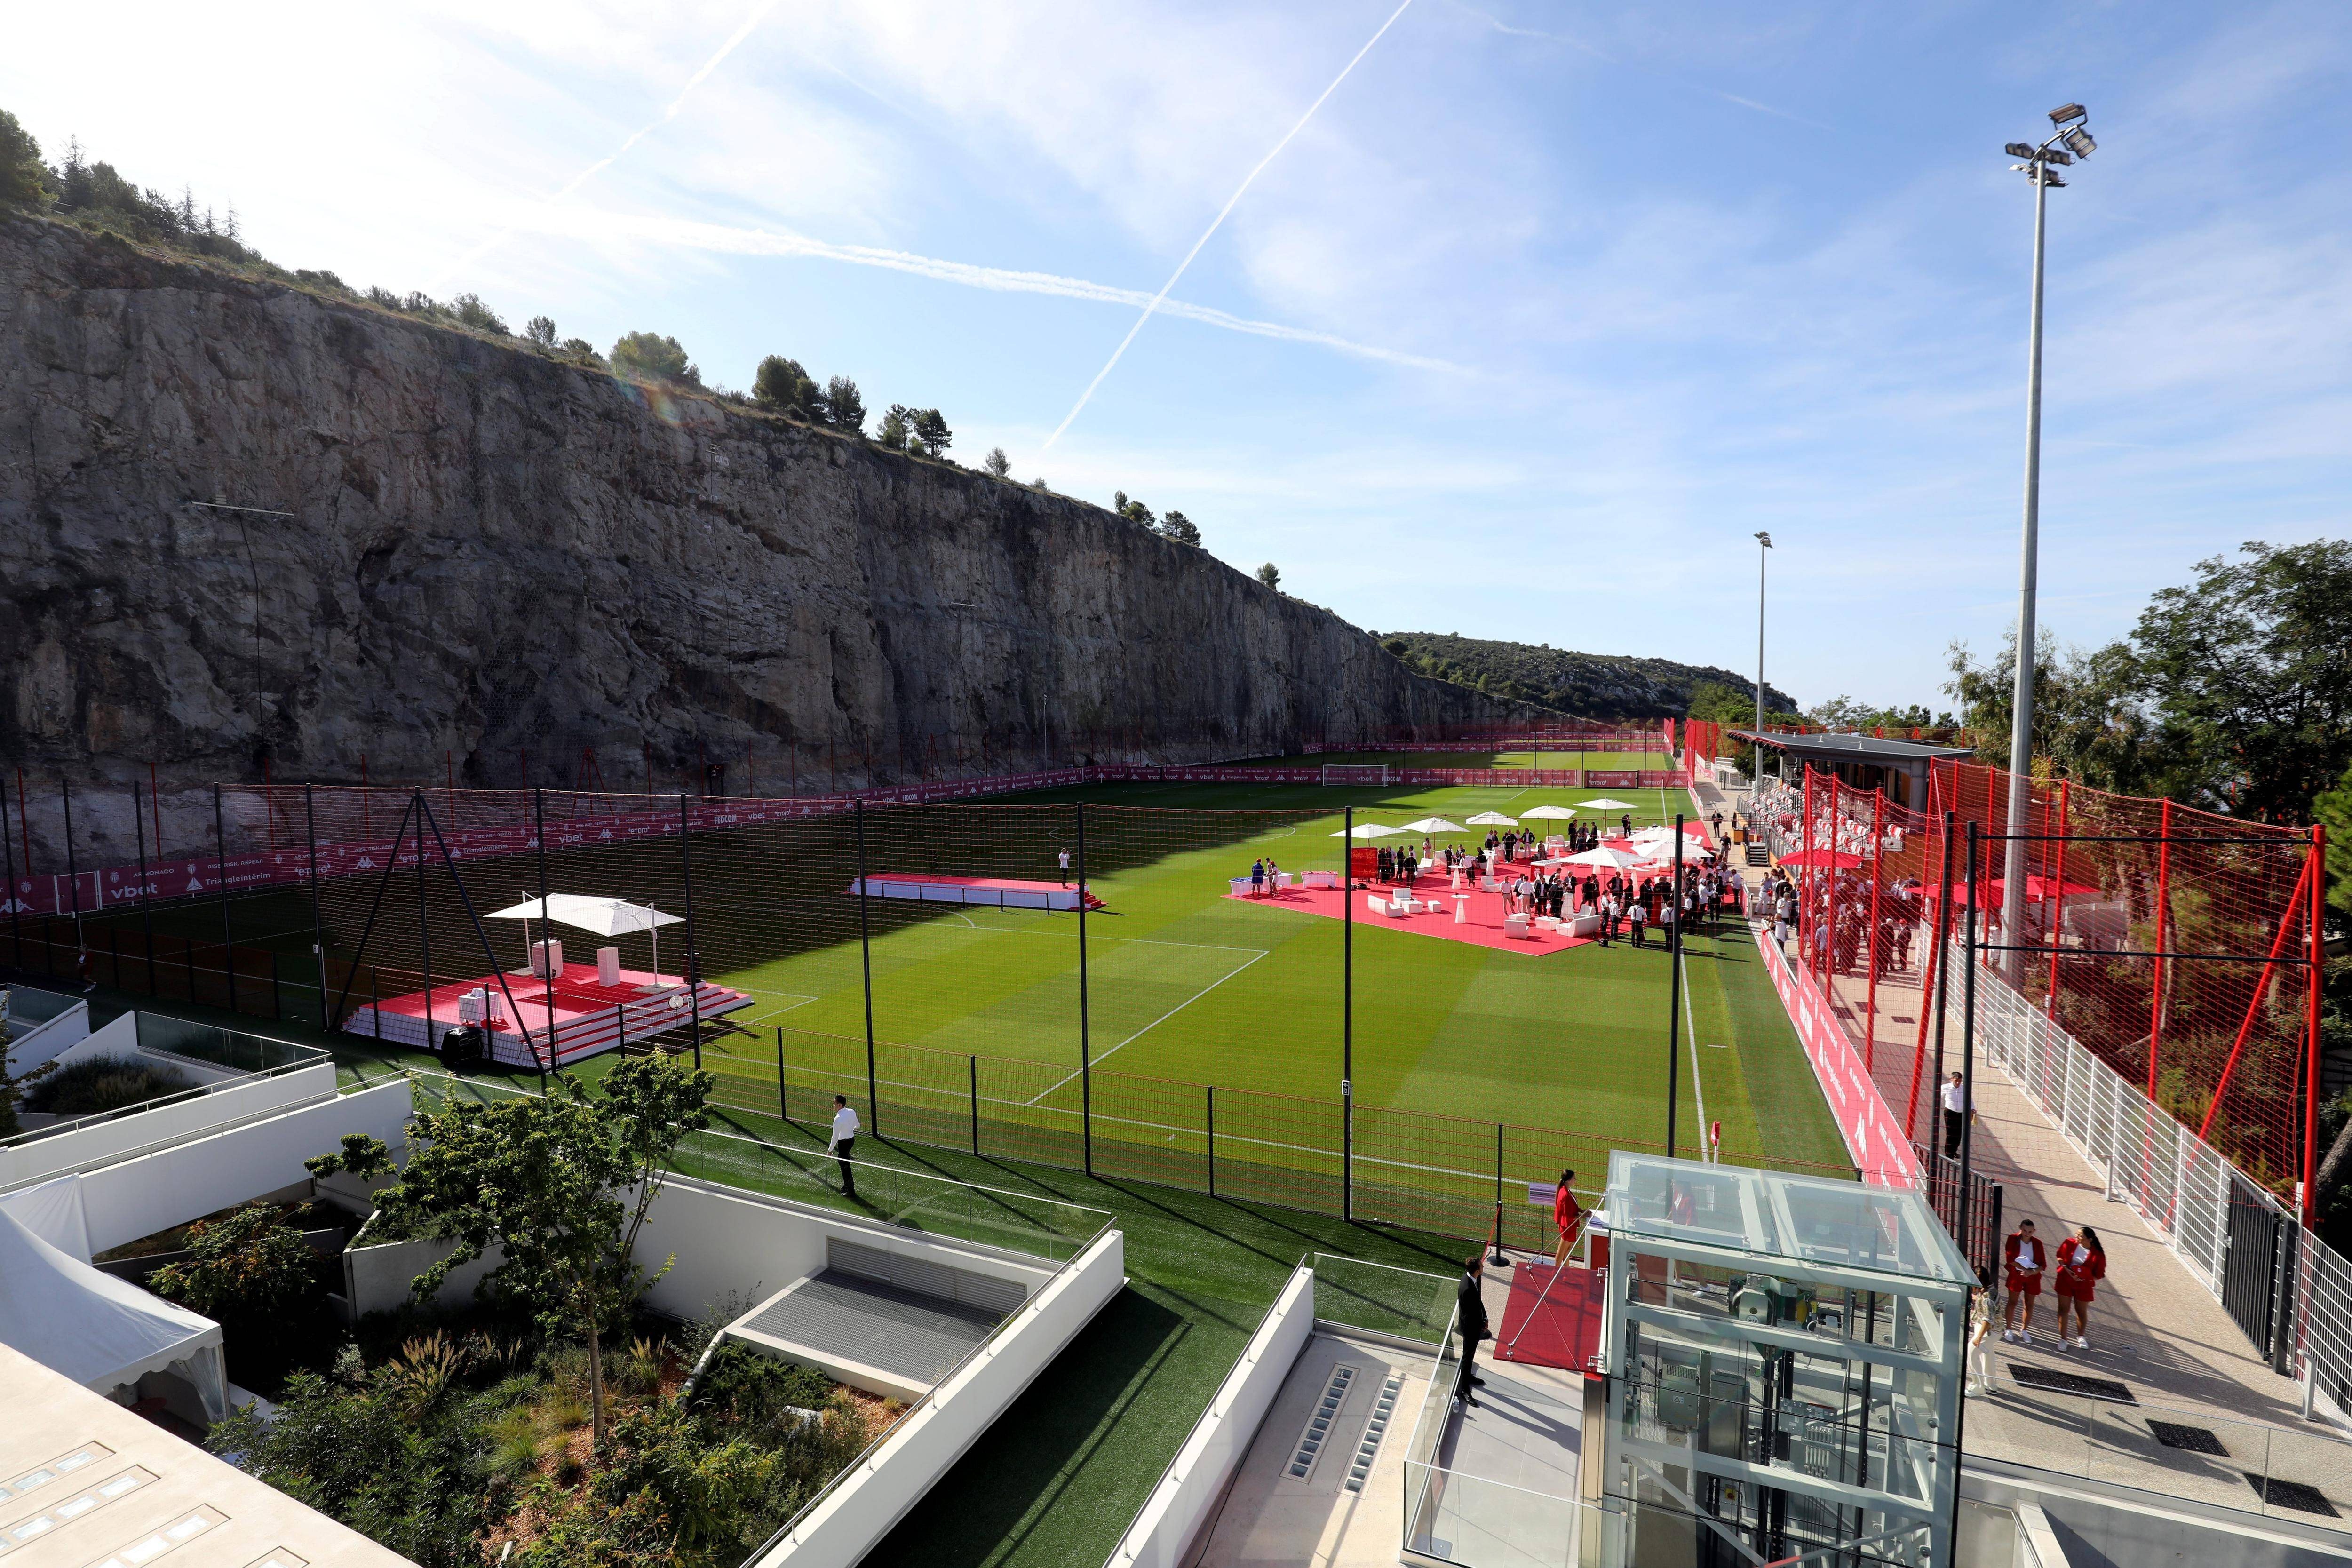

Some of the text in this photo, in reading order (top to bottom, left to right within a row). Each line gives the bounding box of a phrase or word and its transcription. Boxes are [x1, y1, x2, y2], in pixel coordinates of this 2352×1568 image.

[902, 793, 918, 802] FEDCOM
[714, 814, 737, 825] FEDCOM
[748, 812, 765, 820] vbet
[558, 832, 583, 844] vbet
[111, 883, 158, 899] vbet
